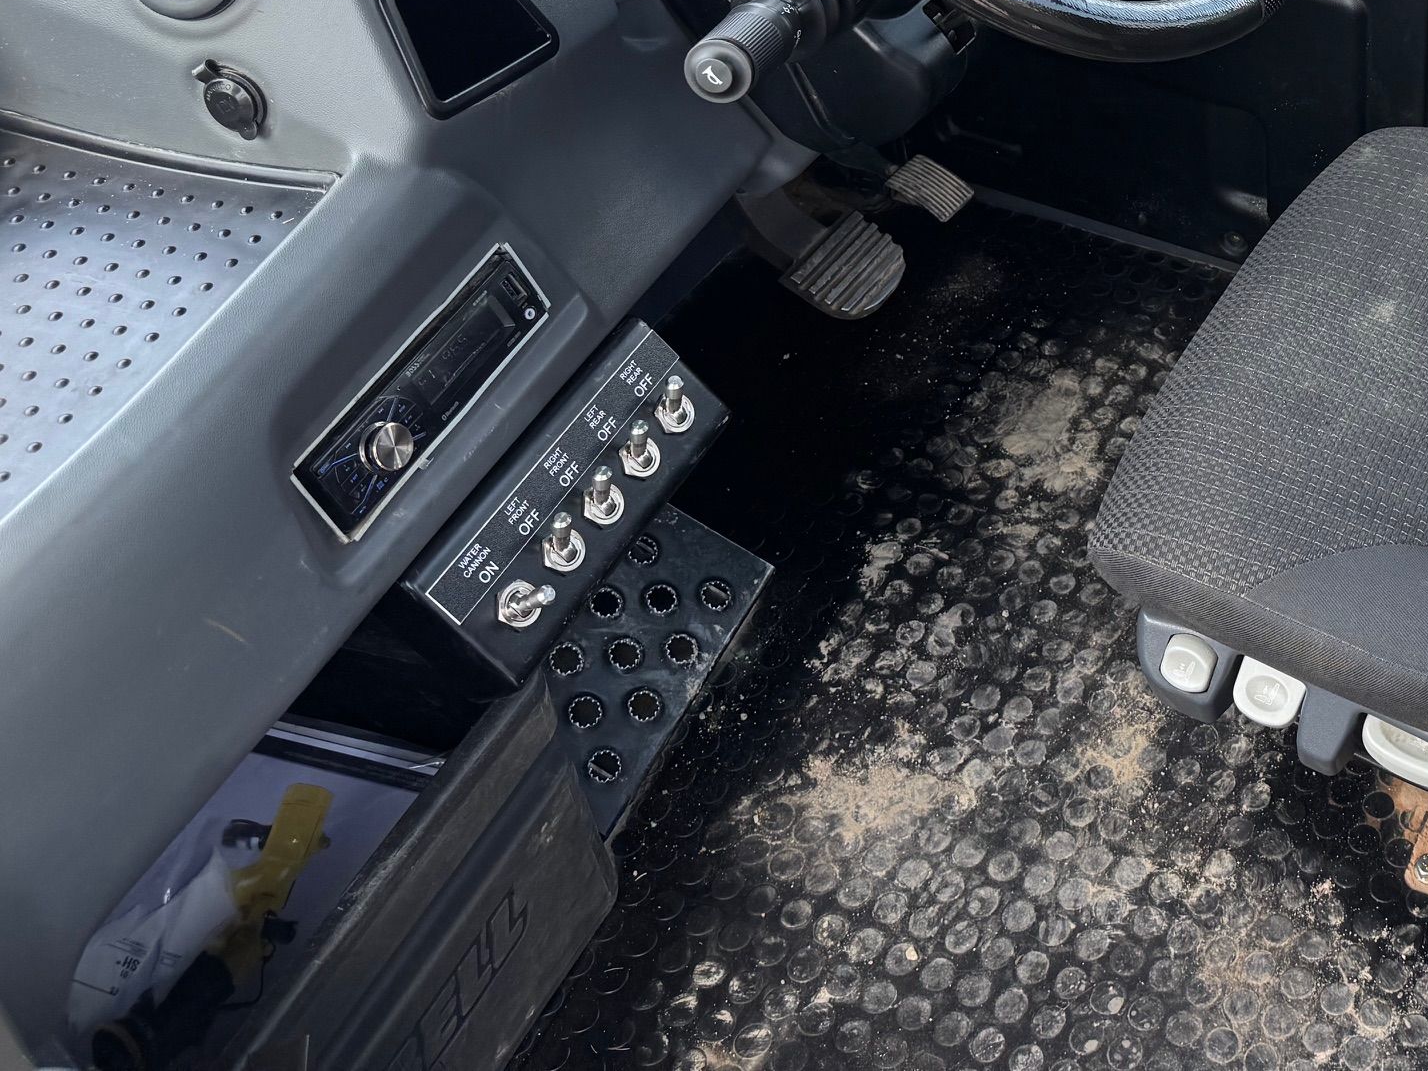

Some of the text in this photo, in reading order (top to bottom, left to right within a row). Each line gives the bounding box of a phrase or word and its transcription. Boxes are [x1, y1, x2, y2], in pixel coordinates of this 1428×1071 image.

[619, 359, 637, 380] RIGHT
[626, 367, 643, 386] REAR
[634, 372, 653, 397] OFF
[584, 404, 599, 422] LEFT
[589, 410, 607, 429] REAR
[597, 416, 617, 441] OFF
[543, 446, 563, 470] RIGHT
[548, 452, 570, 477] FRONT
[559, 460, 580, 487] OFF
[504, 496, 521, 516] LEFT
[508, 499, 530, 525] FRONT
[518, 508, 540, 535] OFF
[458, 543, 482, 569] WATER
[463, 546, 492, 578] CANNON
[479, 560, 500, 583] ON
